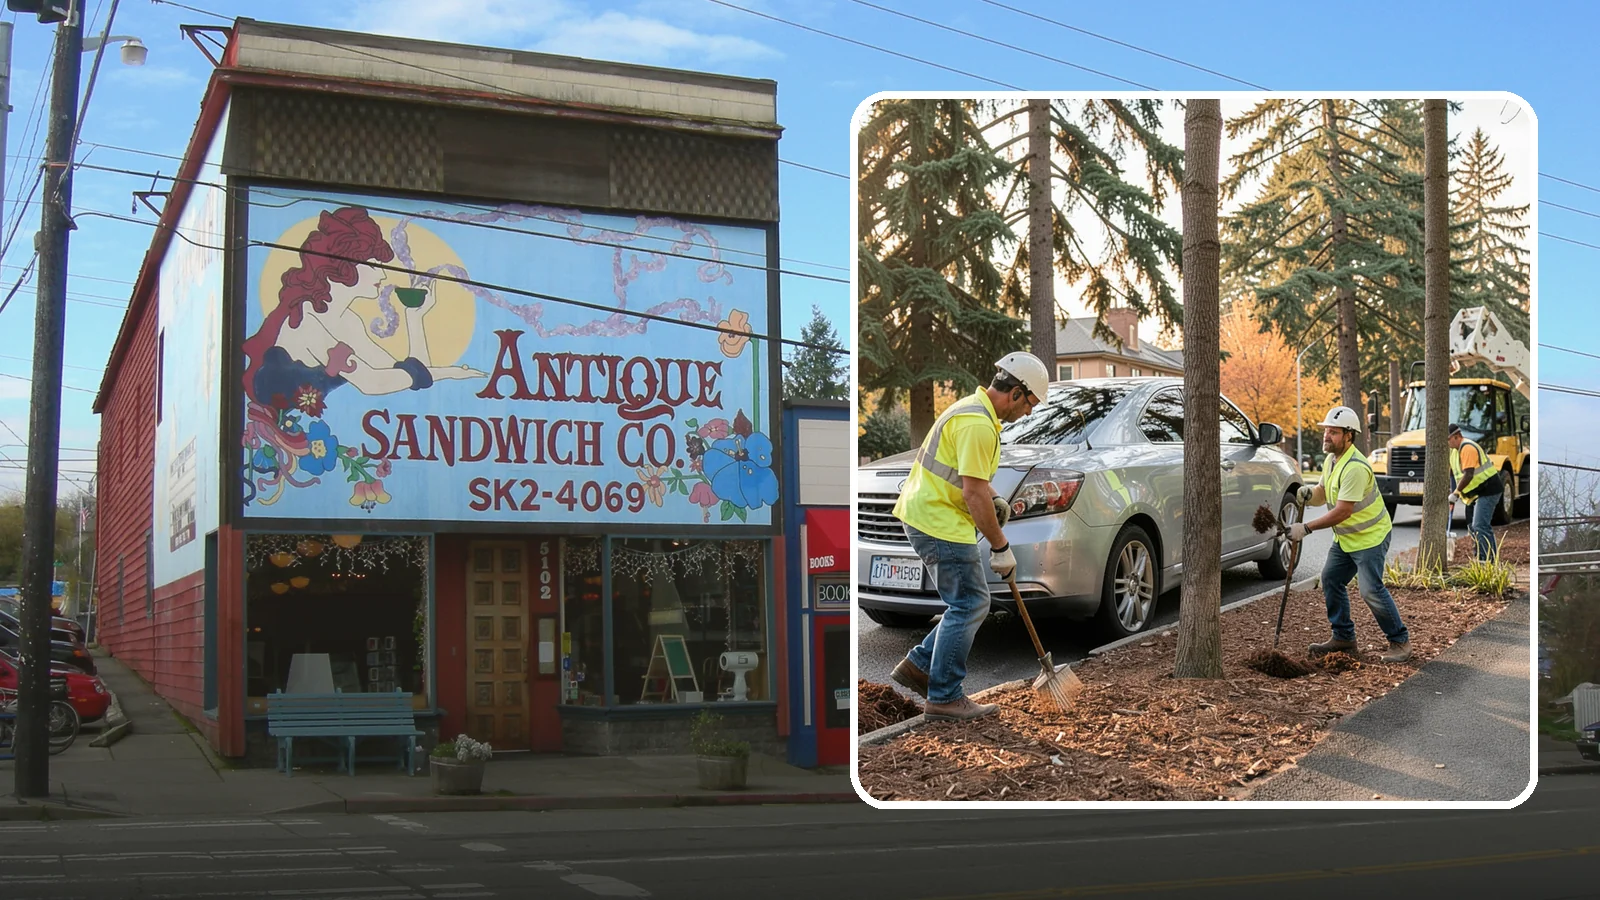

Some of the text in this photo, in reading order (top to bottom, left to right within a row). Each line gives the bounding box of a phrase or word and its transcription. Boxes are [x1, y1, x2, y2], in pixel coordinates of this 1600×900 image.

[475, 328, 724, 421] ANTIQUE
[361, 408, 685, 469] SANDWICH CO.
[468, 477, 645, 513] SK2-4069
[540, 541, 551, 600] 5102
[809, 554, 835, 569] BOOKS
